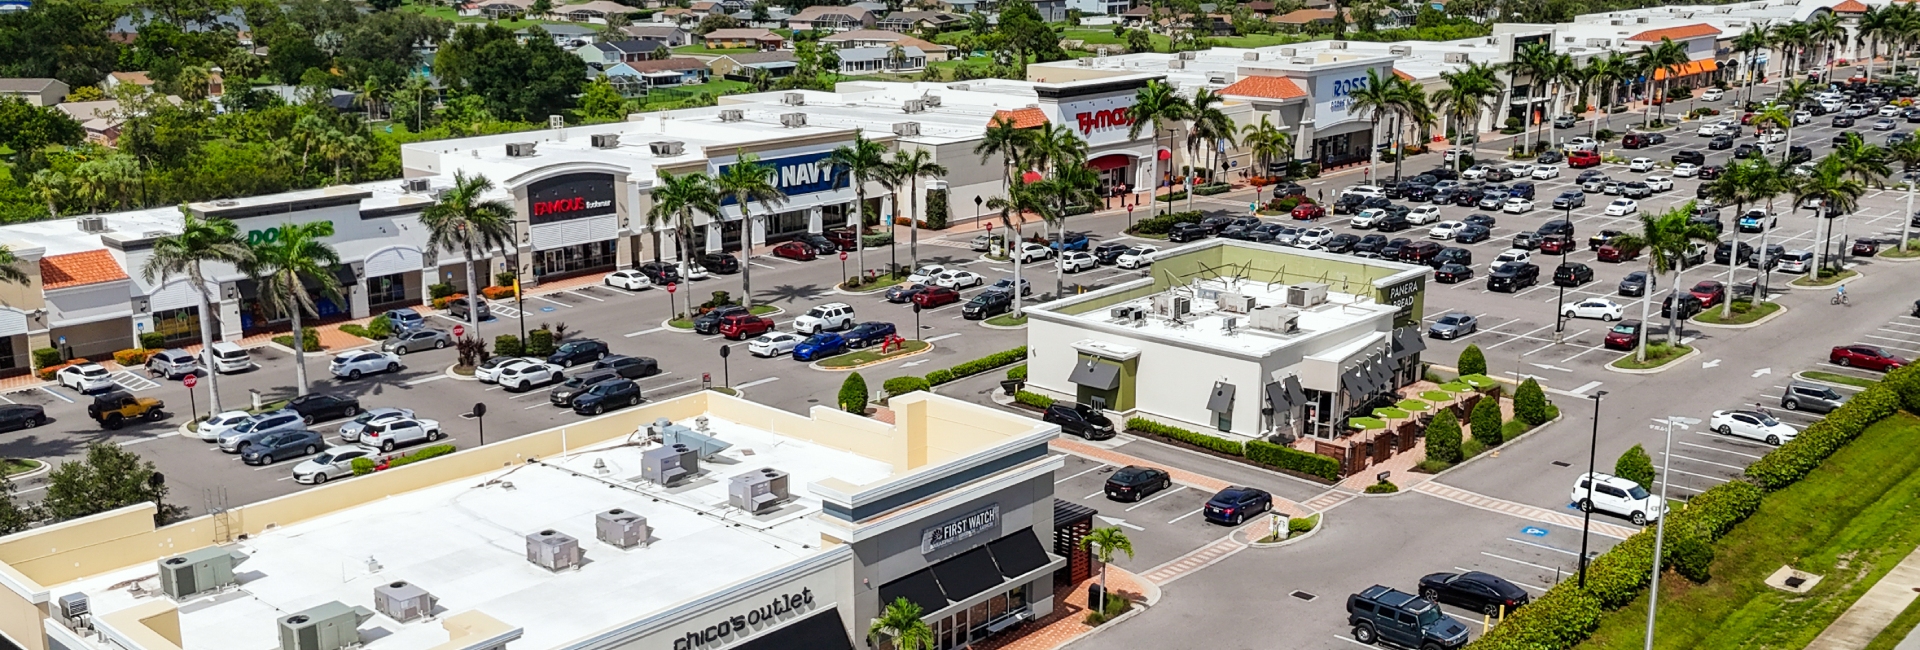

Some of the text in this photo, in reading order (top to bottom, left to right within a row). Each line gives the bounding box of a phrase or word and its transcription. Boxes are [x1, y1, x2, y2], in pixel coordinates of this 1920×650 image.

[1333, 77, 1367, 97] ROSS
[782, 162, 832, 188] NAVY
[534, 197, 584, 216] FAMOUS
[1390, 281, 1418, 299] PANERA
[944, 519, 967, 539] FIRST
[968, 508, 995, 529] WATCH
[674, 587, 813, 650] chico's outlet
